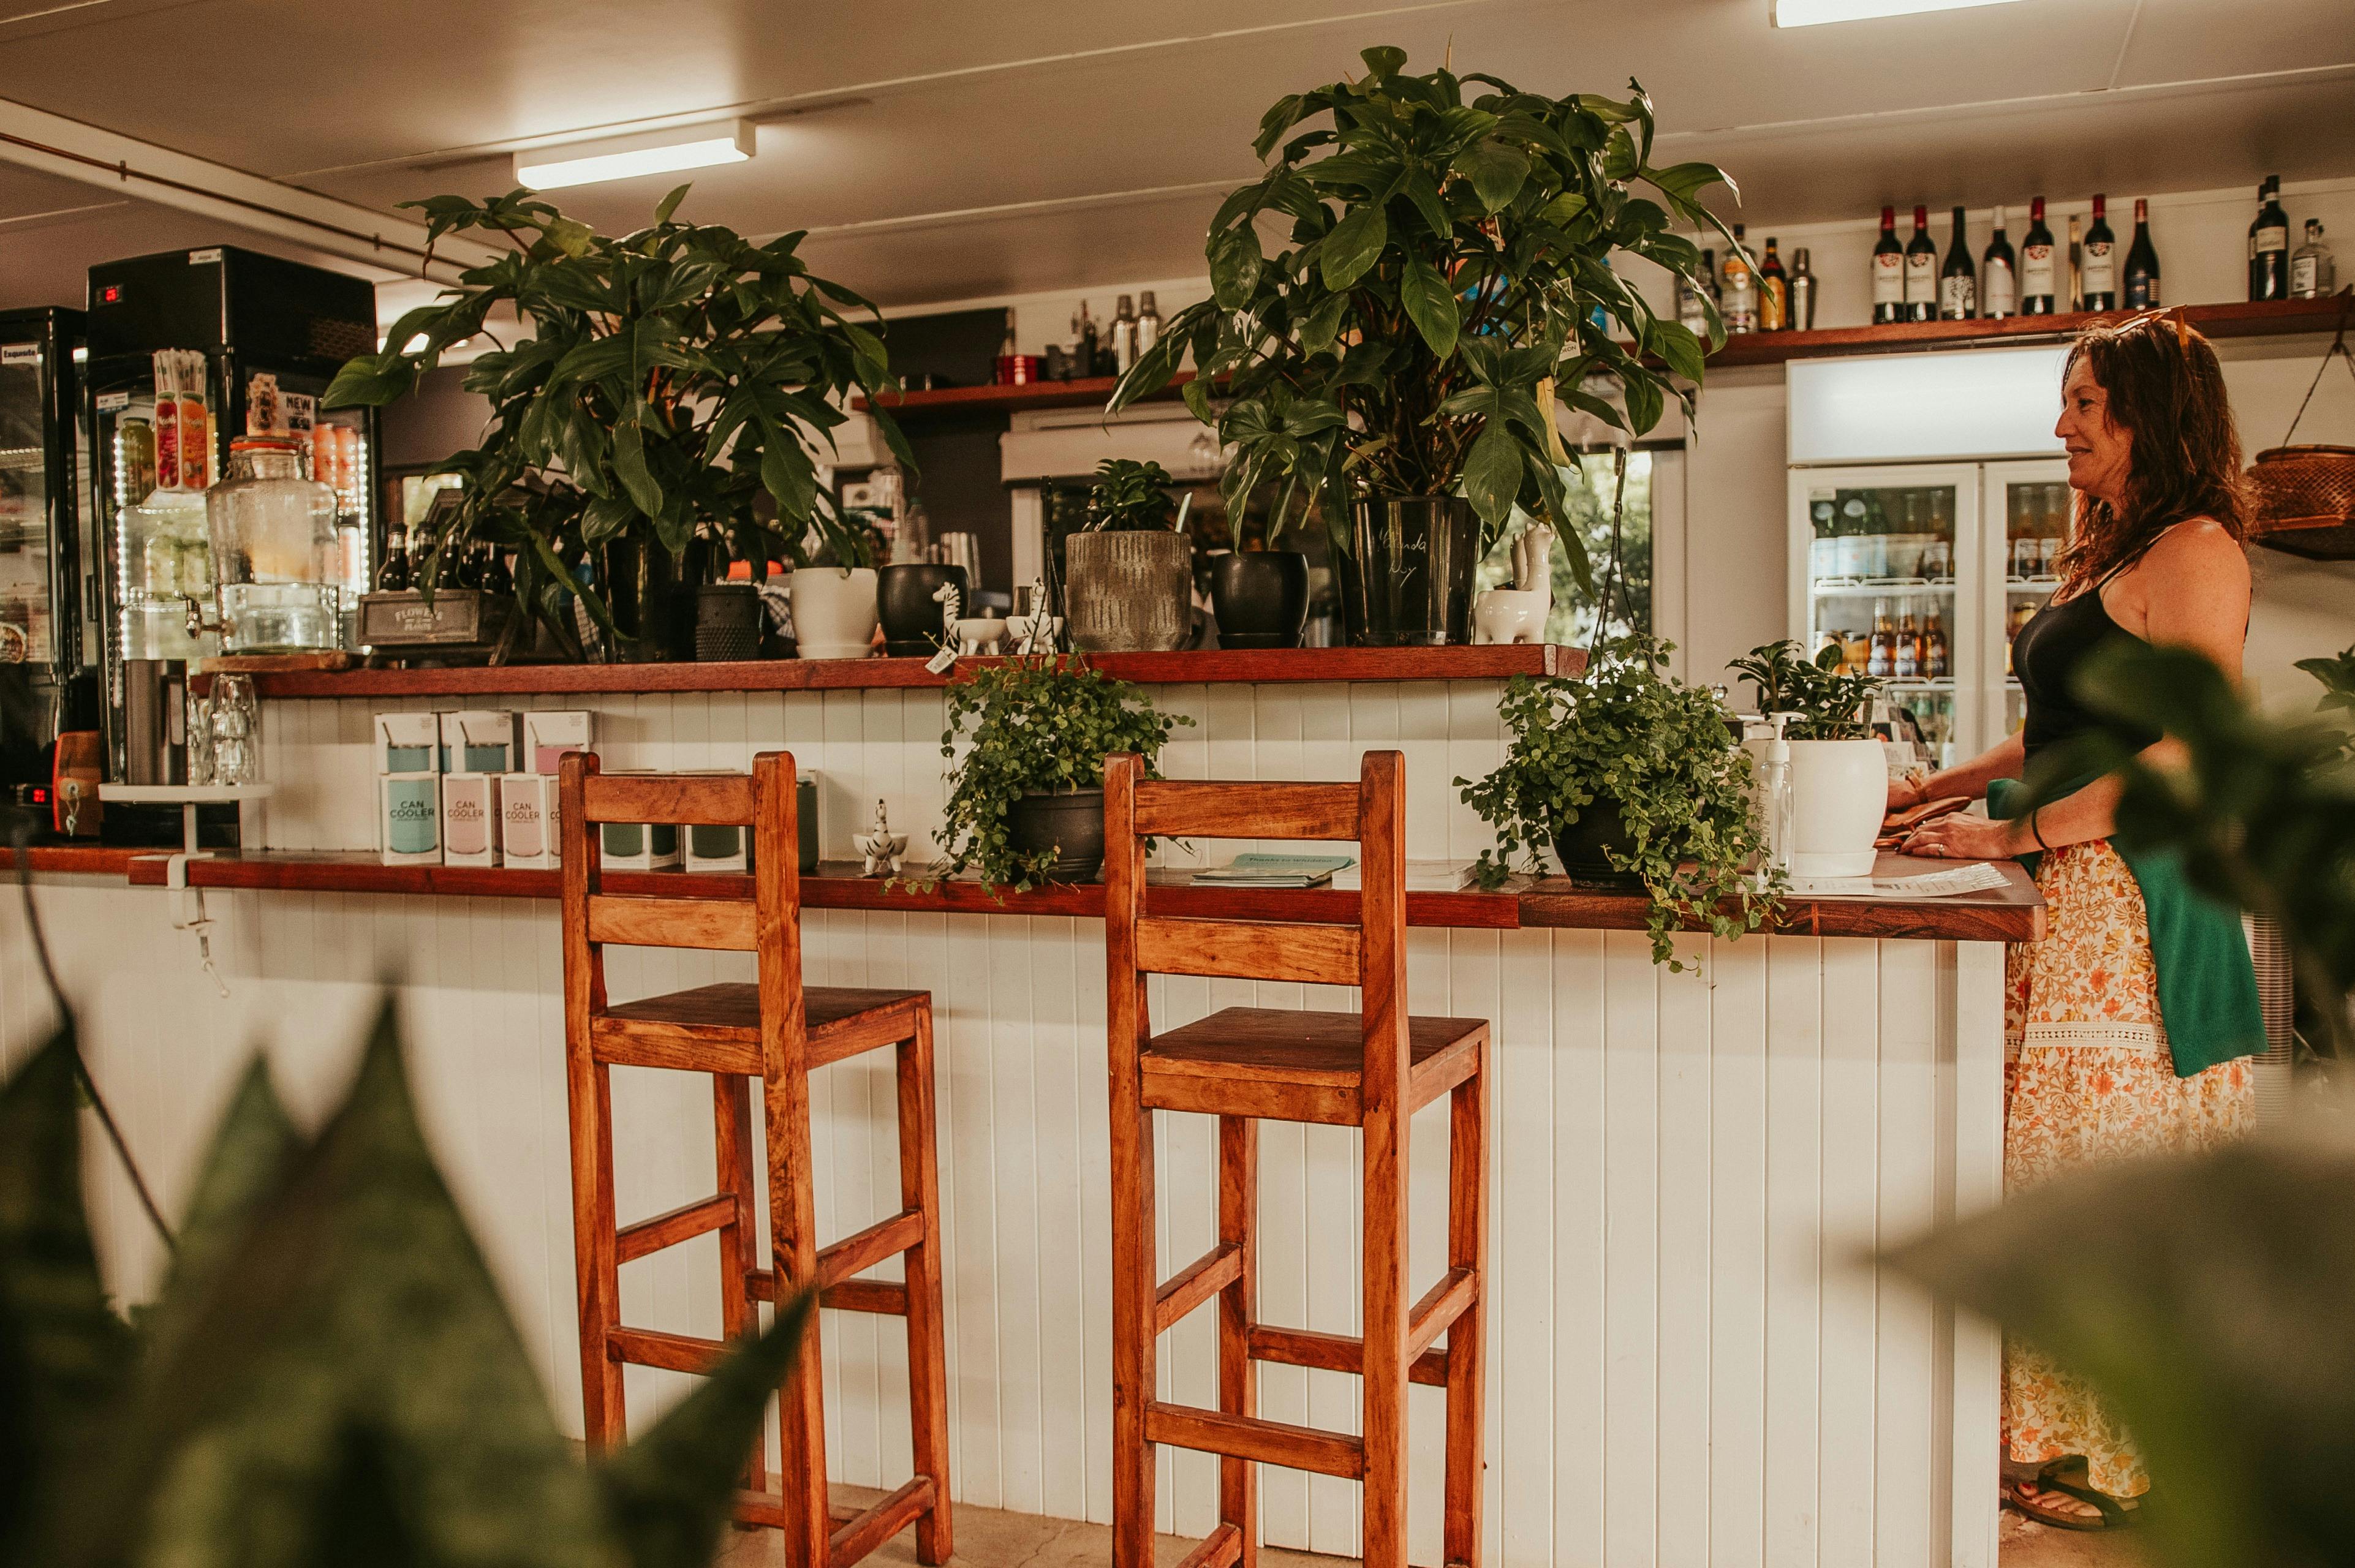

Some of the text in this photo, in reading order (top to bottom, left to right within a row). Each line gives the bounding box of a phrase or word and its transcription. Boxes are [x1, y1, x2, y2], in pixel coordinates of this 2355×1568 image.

[286, 396, 311, 410] NEW
[400, 800, 425, 809] CAN
[455, 800, 475, 809] CAN
[390, 808, 435, 818] COOLER
[447, 809, 484, 818] COOLER
[505, 810, 540, 820] COOLER
